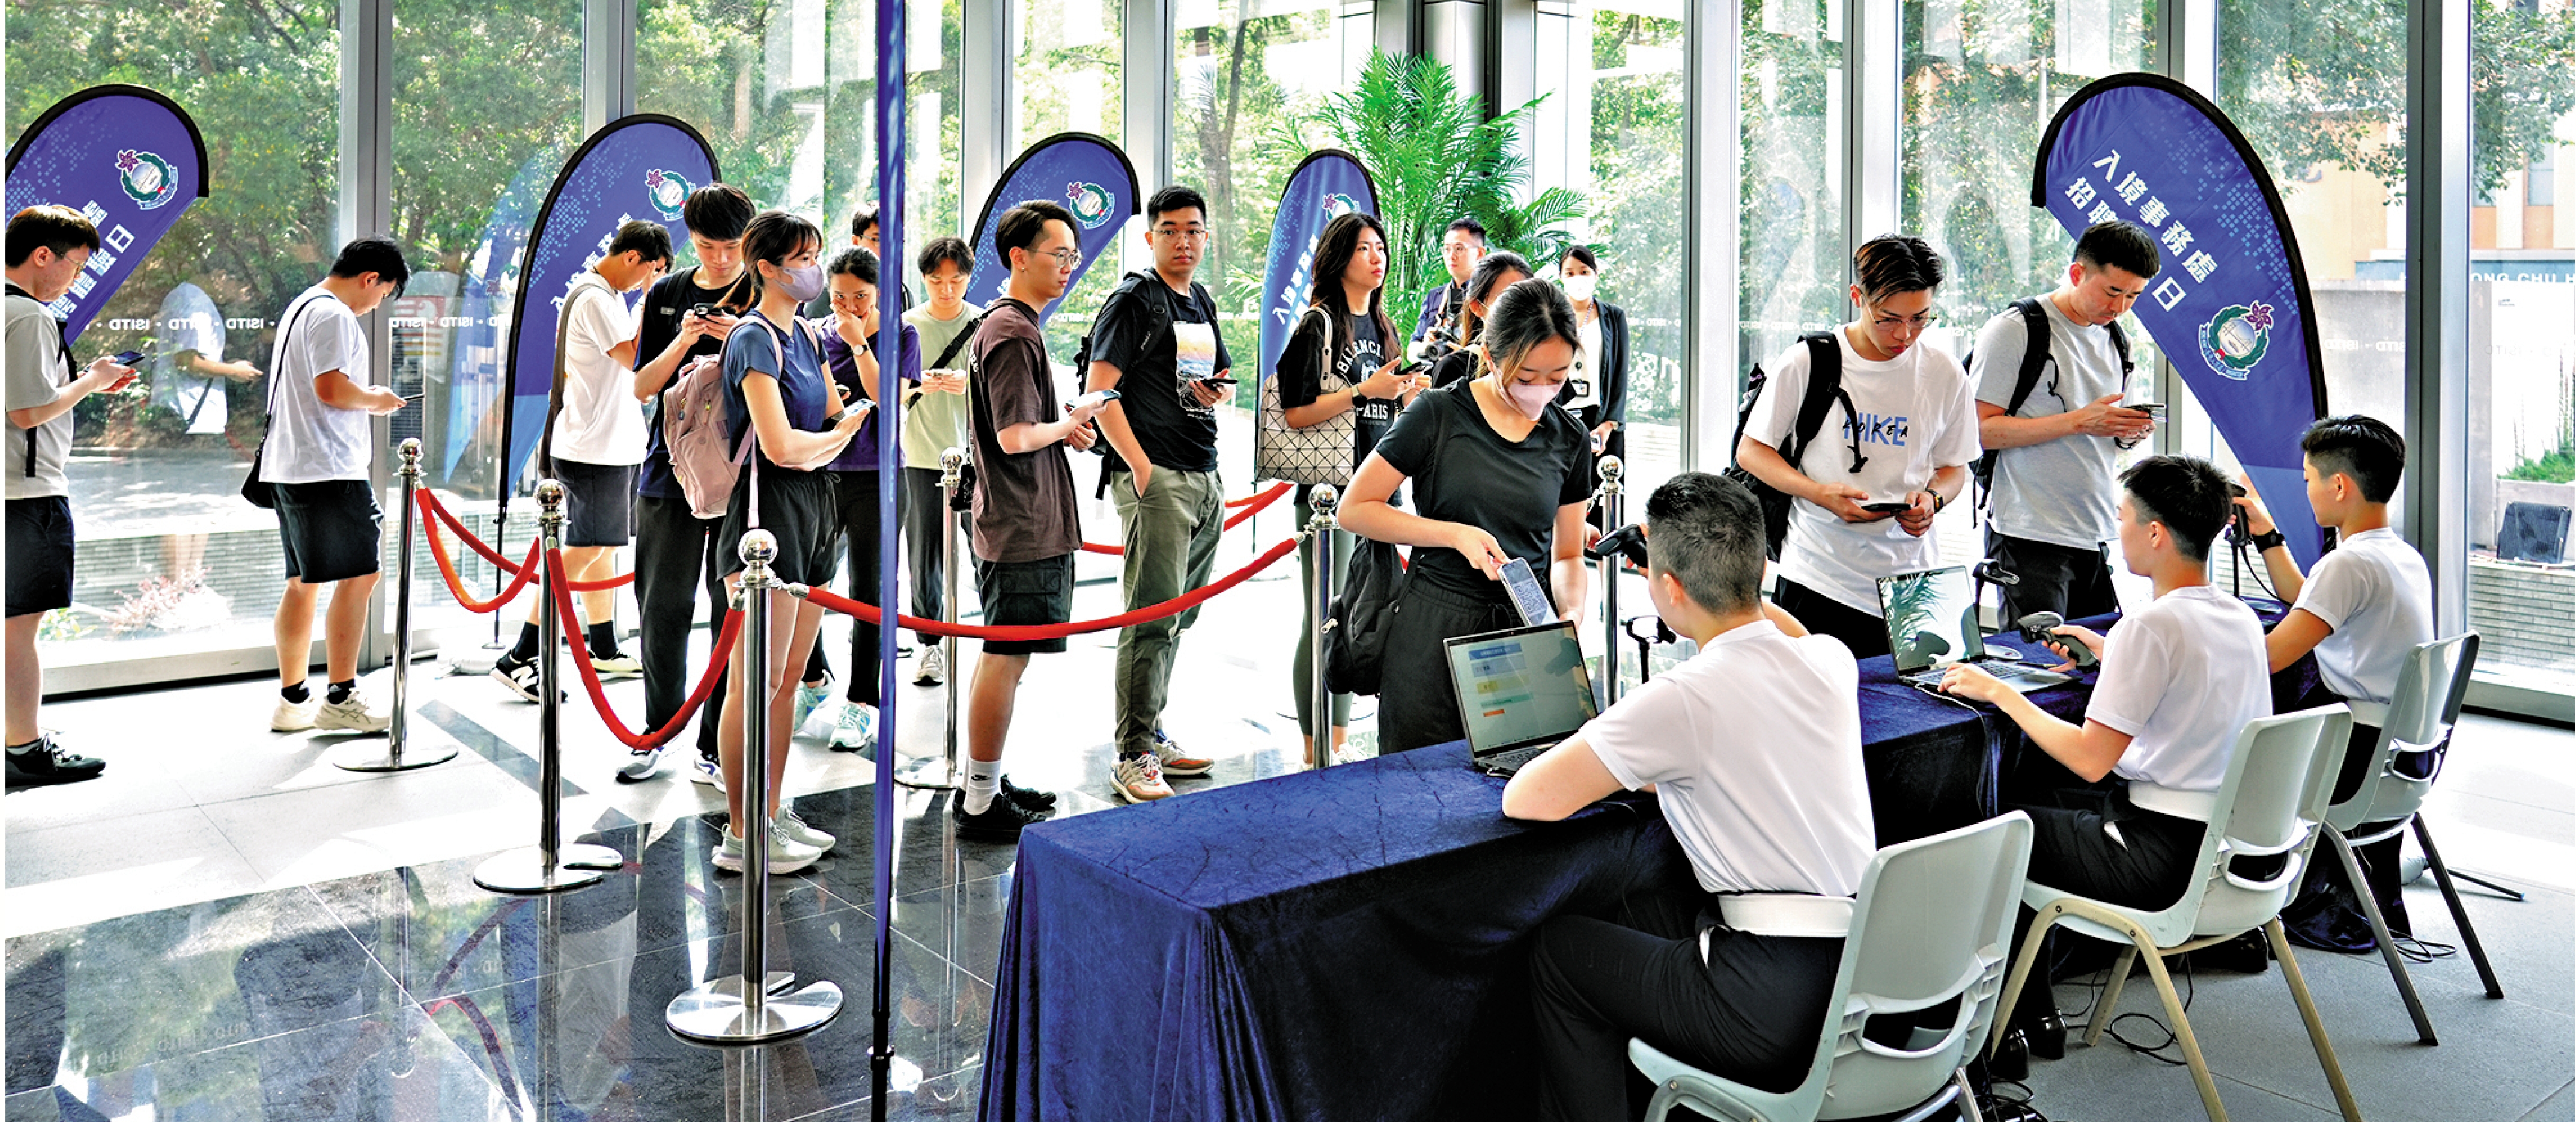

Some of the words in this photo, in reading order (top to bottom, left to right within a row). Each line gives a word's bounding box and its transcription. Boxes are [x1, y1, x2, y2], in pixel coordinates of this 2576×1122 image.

[48, 224, 135, 320] 聘體驗日
[2065, 177, 2187, 312] 招聘日
[2092, 149, 2218, 283] 入境事務處
[2470, 272, 2509, 282] ONG
